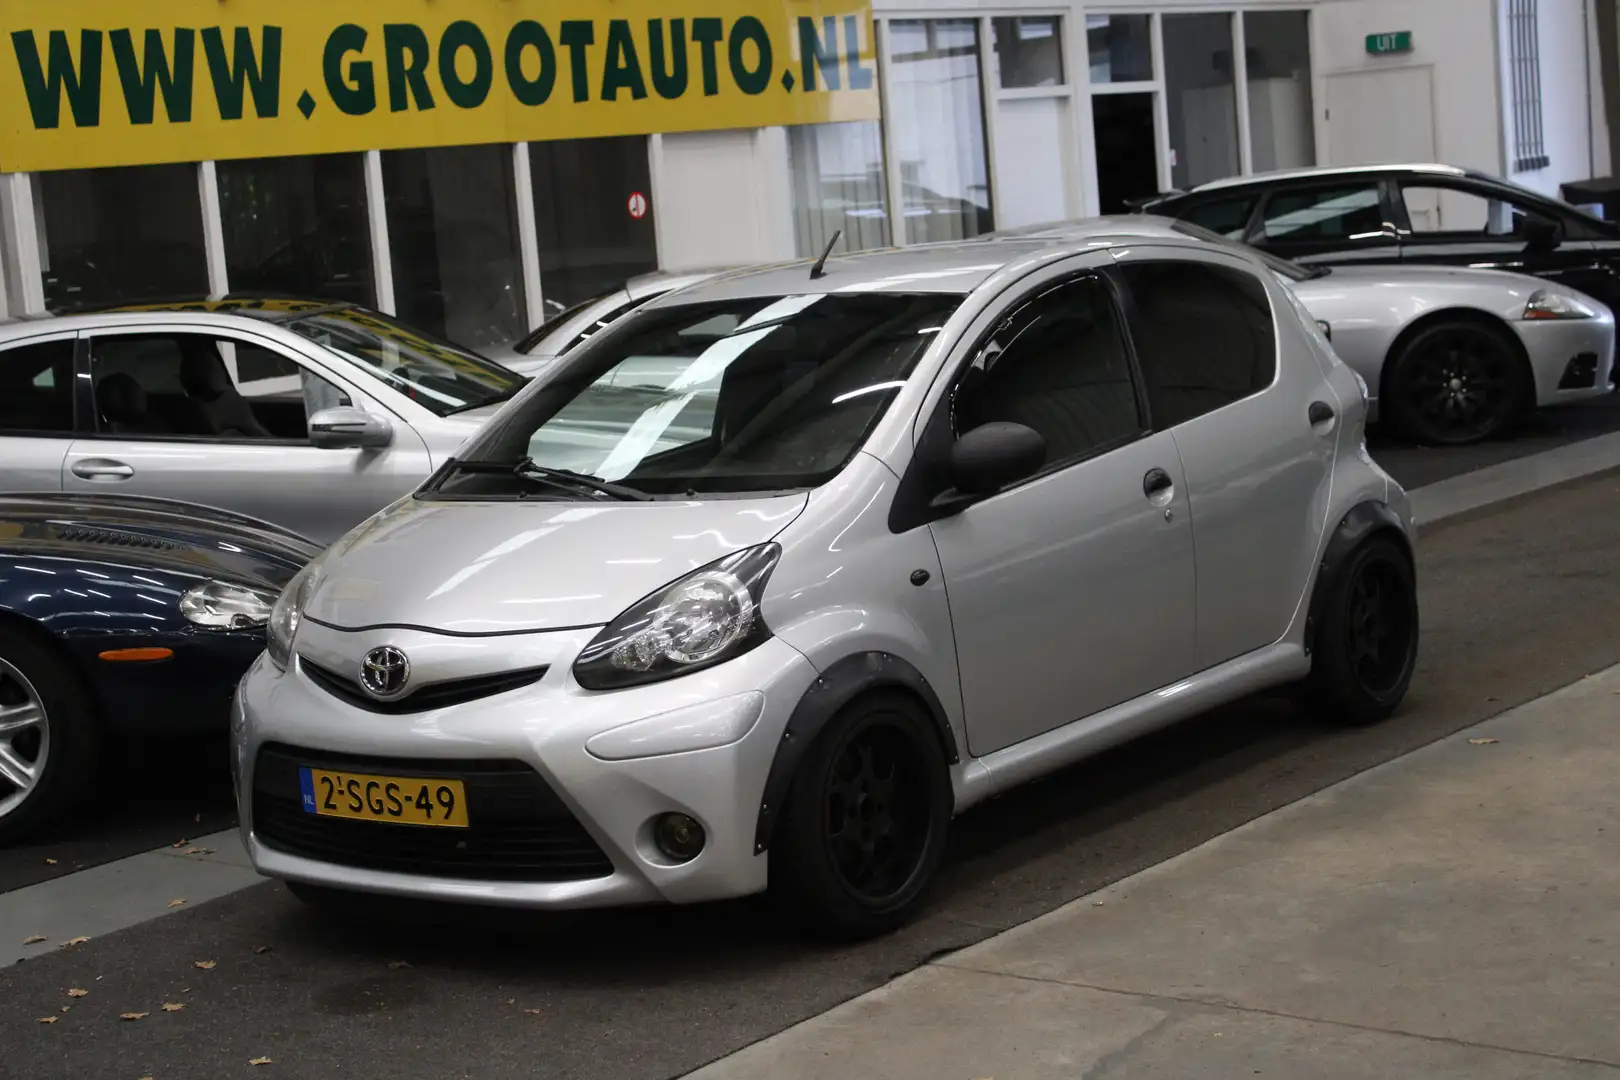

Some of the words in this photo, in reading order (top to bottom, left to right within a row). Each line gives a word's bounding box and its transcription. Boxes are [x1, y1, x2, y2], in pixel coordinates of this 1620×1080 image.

[1376, 34, 1397, 52] UIT
[10, 16, 873, 129] WWW.GROOTAUTO.NL
[303, 794, 316, 805] NL
